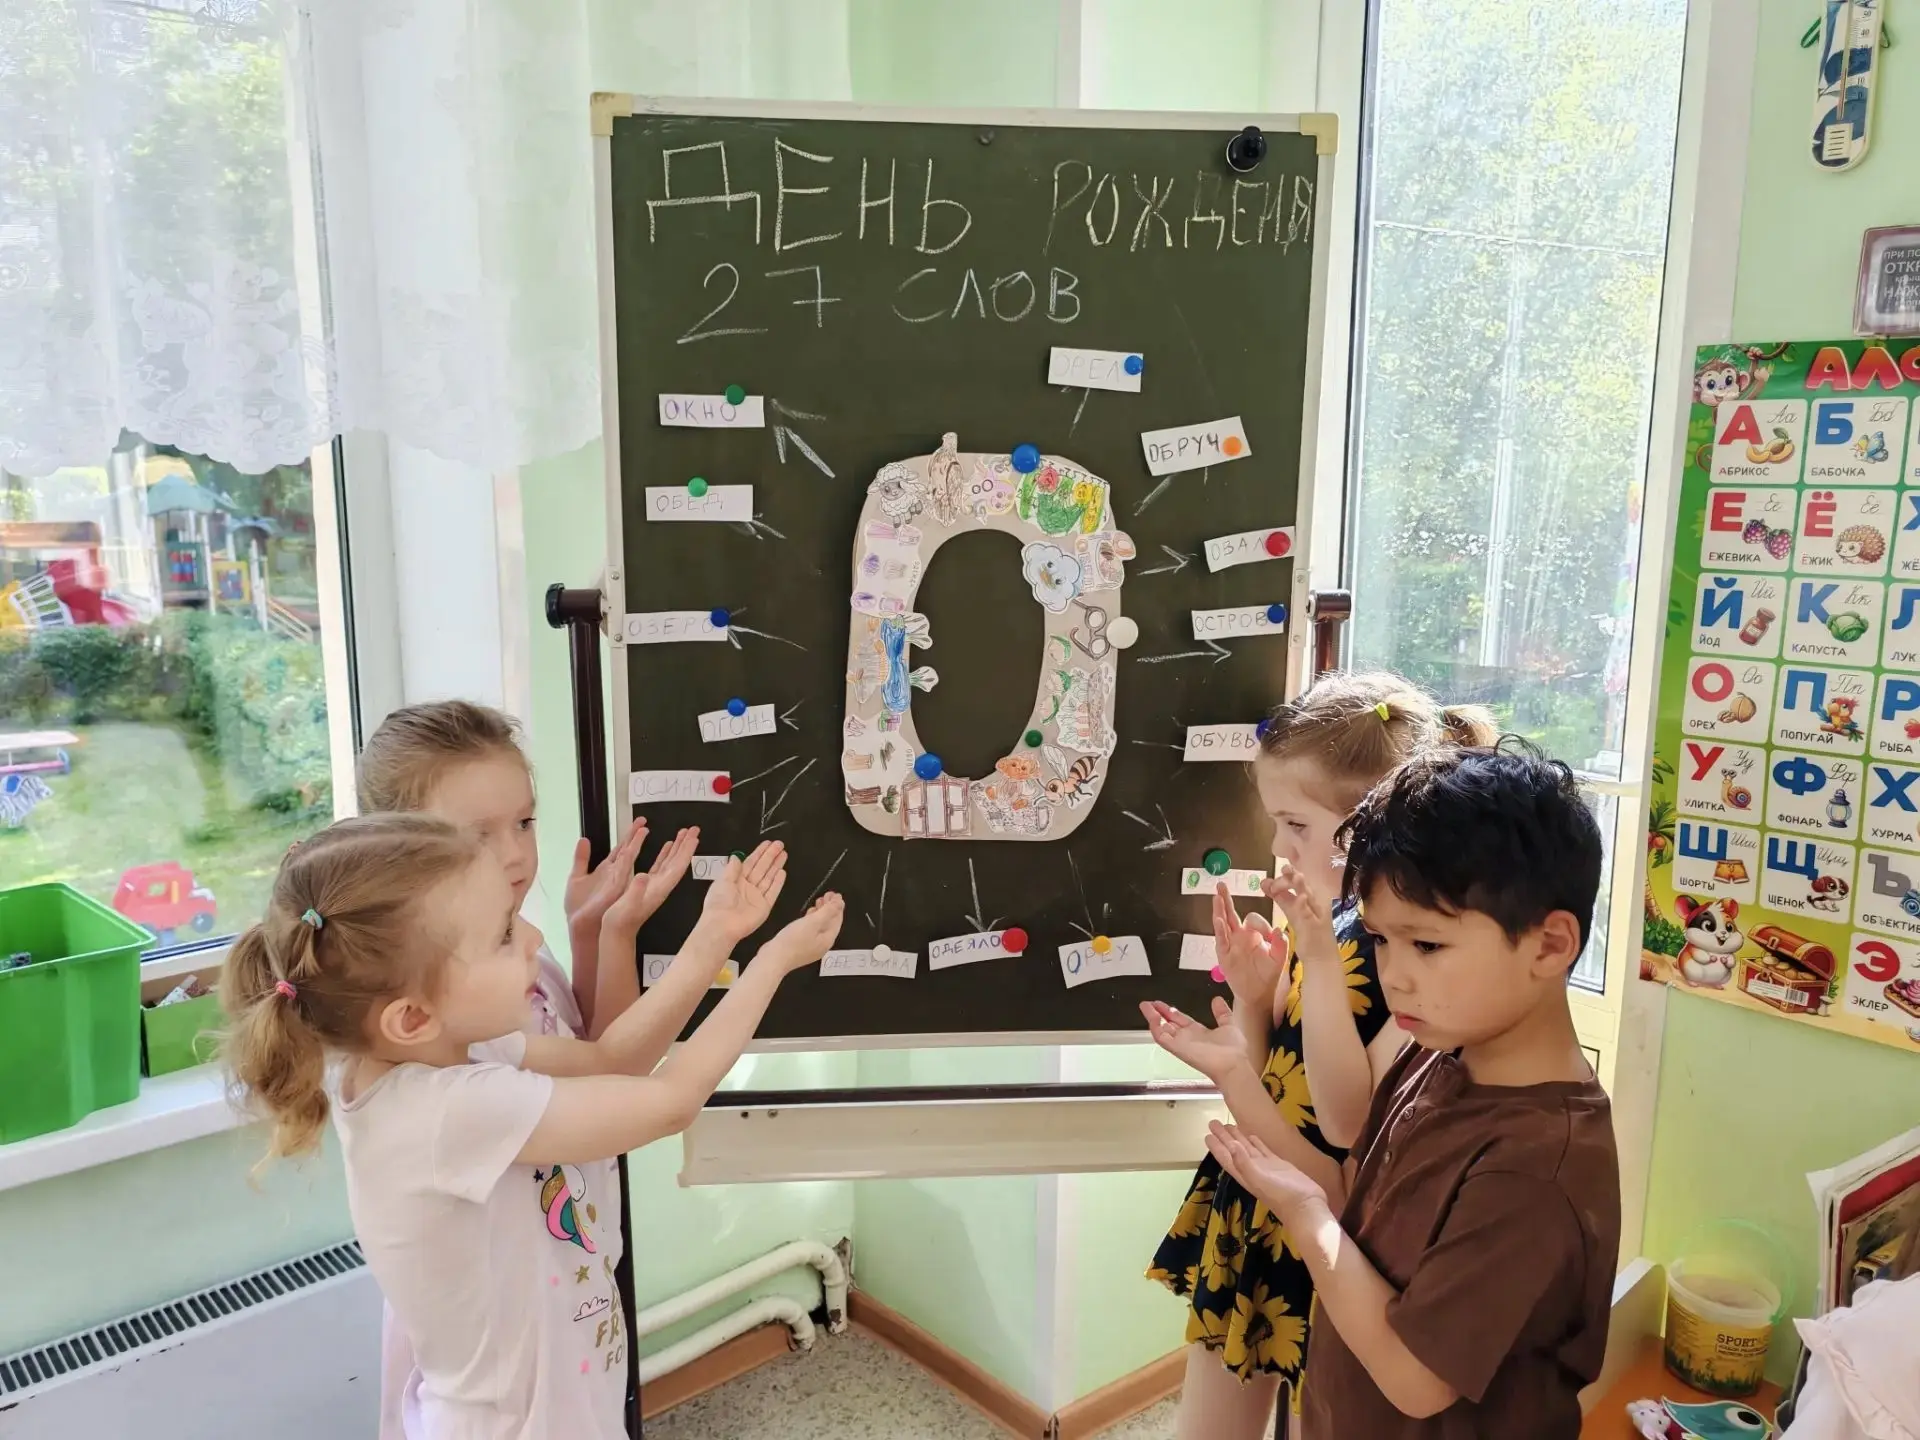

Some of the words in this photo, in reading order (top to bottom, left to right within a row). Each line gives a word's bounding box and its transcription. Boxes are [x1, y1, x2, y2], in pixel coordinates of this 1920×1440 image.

[647, 137, 972, 255] ДЕНЬ
[893, 266, 1081, 323] СЛОВ
[664, 399, 737, 425] ОКНО
[1718, 404, 1764, 445] А
[1815, 402, 1855, 445] Б
[1149, 432, 1220, 463] ОБРУЧ
[1719, 466, 1770, 477] АБРИКОС
[1811, 466, 1866, 478] БАБОЧКА
[656, 493, 724, 513] ОБЕД
[1710, 492, 1746, 532] Е
[1804, 490, 1837, 538] Ё
[1708, 551, 1761, 563] ЕЖЕВИКА
[1801, 553, 1833, 567] ЁЖИК
[1701, 576, 1744, 630] Й
[1797, 582, 1841, 625] К
[628, 616, 715, 637] ОЗЕРО
[1194, 611, 1268, 632] ОСТРОВ
[1699, 633, 1721, 648] ЙОД
[1791, 644, 1847, 657] КАПУСТА
[1890, 651, 1916, 663] ЛУК
[1691, 662, 1735, 703] О
[1783, 669, 1828, 713] П
[701, 711, 773, 741] ОГОНЬ
[1689, 719, 1717, 730] ОРЕХ
[1780, 728, 1834, 744] ПОПУГАЙ
[1190, 732, 1256, 748] ОБУВЬ
[1879, 741, 1914, 754] РЫБА
[1686, 742, 1725, 782] У
[1773, 756, 1827, 796] Ф
[1870, 766, 1920, 813] Х
[1684, 798, 1726, 813] УЛИТКА
[1777, 813, 1823, 828] ФОНАРЬ
[1678, 822, 1729, 862] Ш
[1871, 828, 1914, 843] ХУРМА
[1767, 837, 1820, 881] Щ
[1679, 877, 1715, 892] ШОРТЫ
[1867, 853, 1911, 898] Ъ
[1767, 893, 1806, 910] ЩЕНОК
[931, 934, 1001, 959] ОДЕЯЛО
[1854, 940, 1900, 983] Э
[1851, 995, 1889, 1012] ЭКЛЕР
